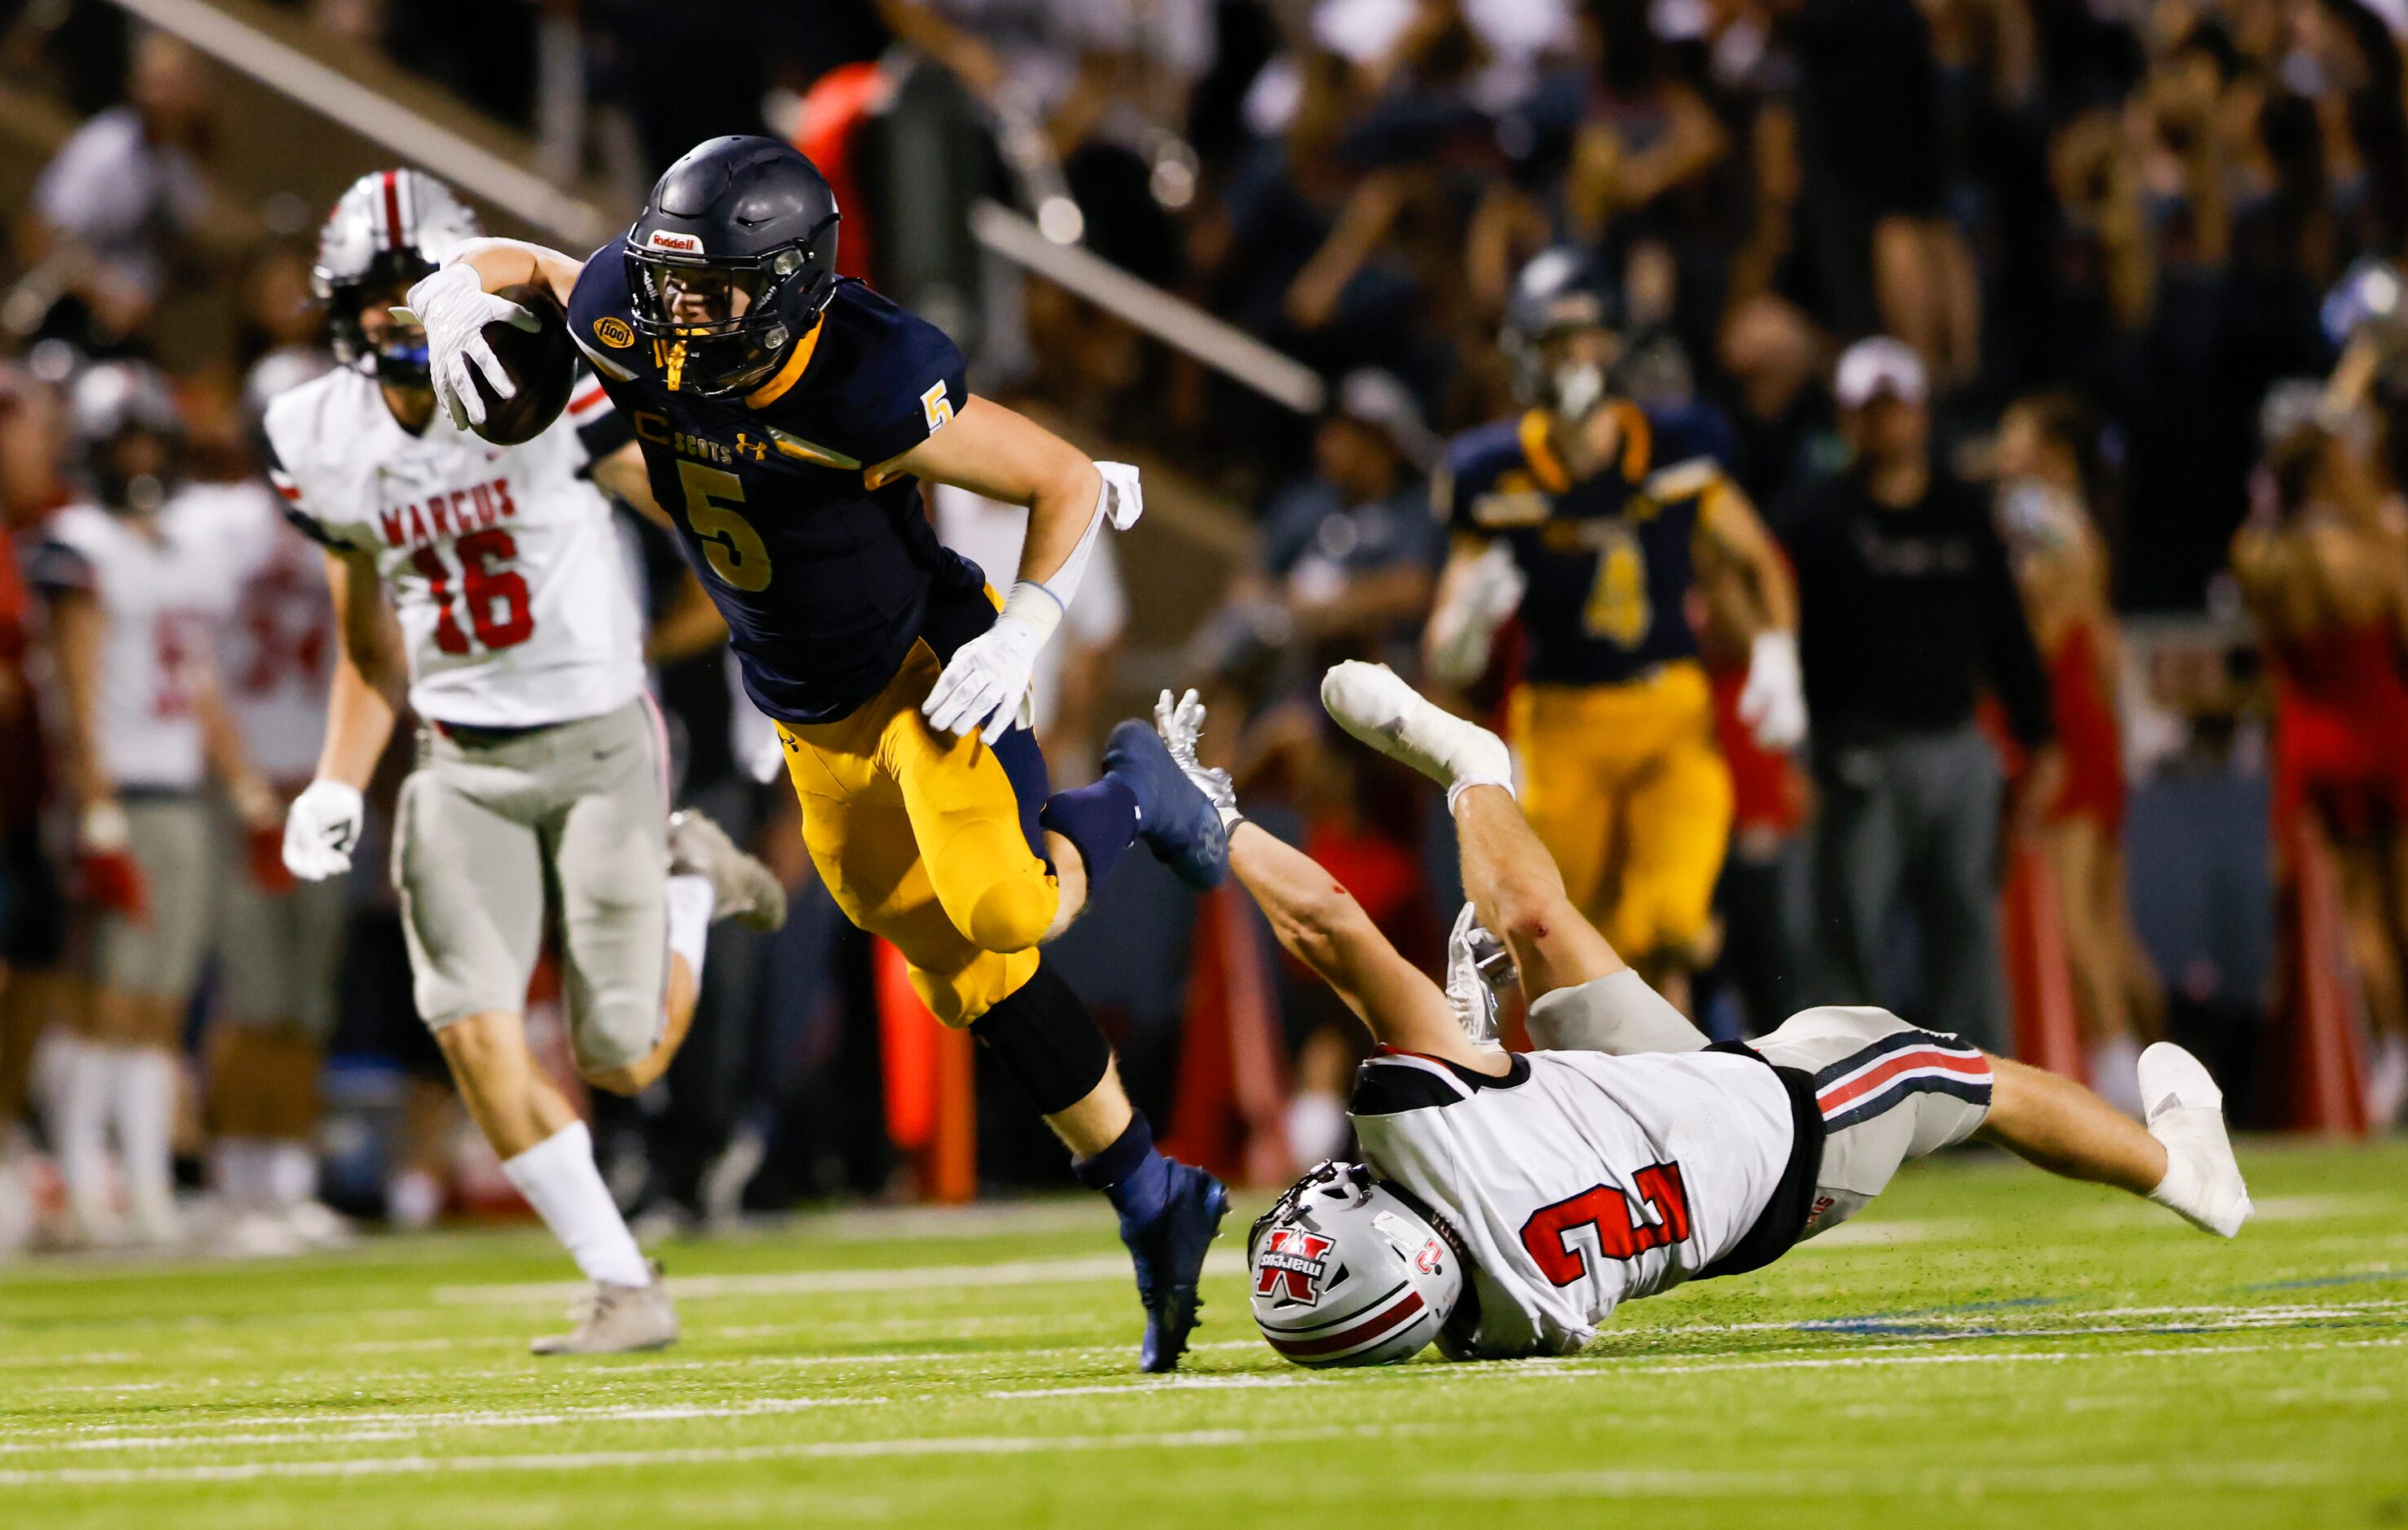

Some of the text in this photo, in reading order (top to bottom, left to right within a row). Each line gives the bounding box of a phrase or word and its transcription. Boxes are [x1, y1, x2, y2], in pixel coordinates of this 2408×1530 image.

[653, 234, 695, 250] Riddell
[604, 325, 624, 341] 100
[675, 432, 732, 465] SCOTS
[380, 476, 516, 547] MARCUS
[675, 458, 773, 592] 5
[410, 526, 534, 656] 16
[1518, 1160, 1690, 1288] 2
[1260, 1252, 1324, 1278] marcus
[1414, 1238, 1443, 1275] 2
